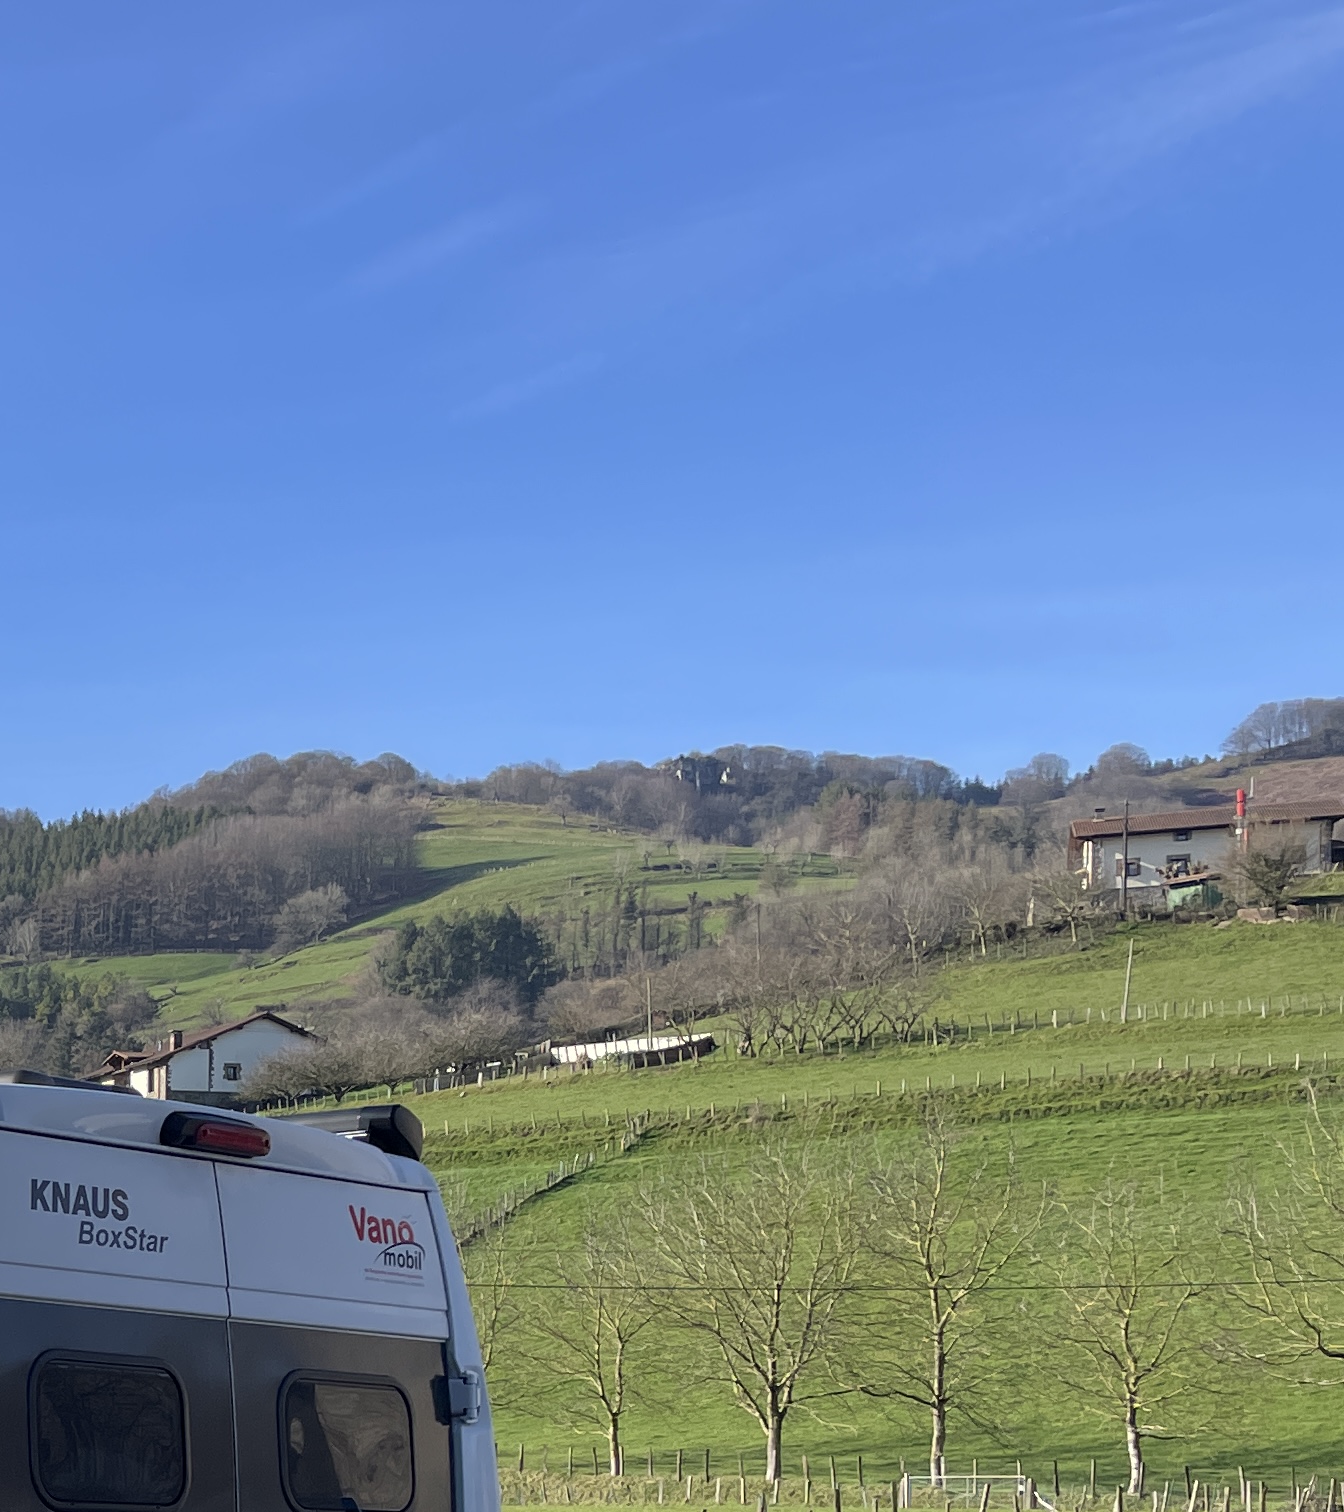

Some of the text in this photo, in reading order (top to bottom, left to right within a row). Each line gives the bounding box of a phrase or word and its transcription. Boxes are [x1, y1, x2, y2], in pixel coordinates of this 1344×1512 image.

[30, 1178, 129, 1221] KNAUS
[78, 1220, 169, 1253] BoxStar
[348, 1204, 414, 1245] Vano
[383, 1249, 422, 1270] mobil
